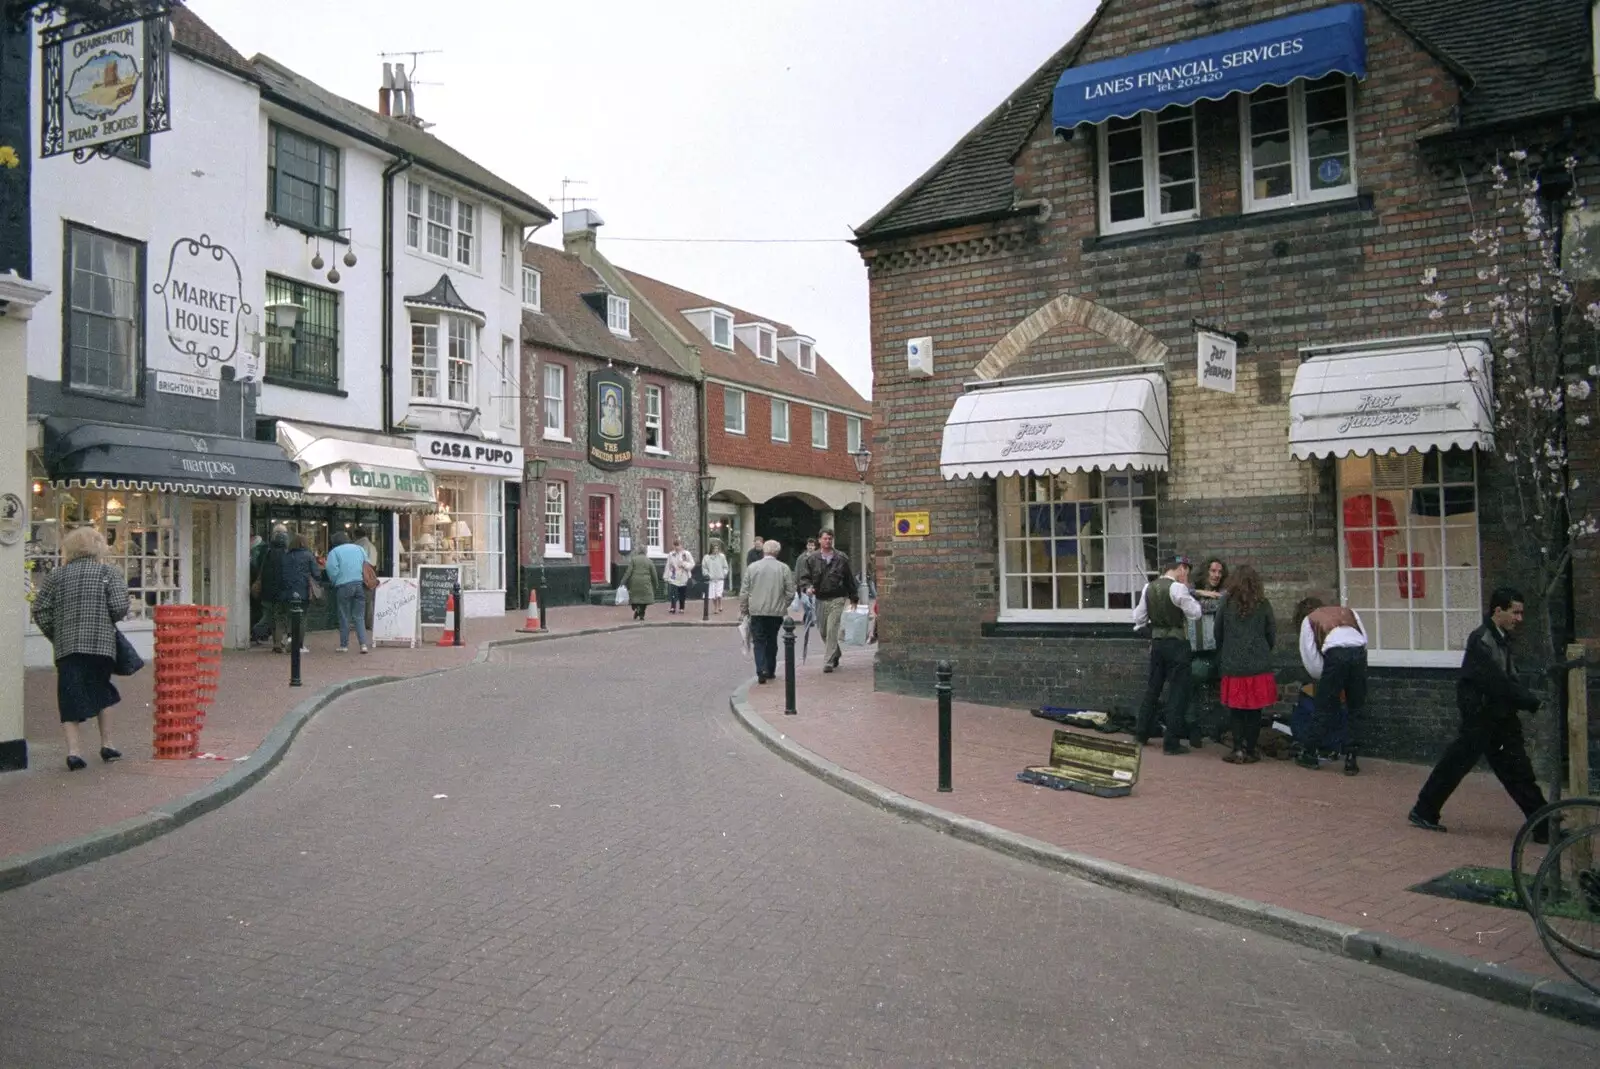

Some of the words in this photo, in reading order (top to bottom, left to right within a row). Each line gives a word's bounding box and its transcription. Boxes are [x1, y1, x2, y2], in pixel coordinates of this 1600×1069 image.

[73, 27, 134, 59] CHARRINGTON
[1085, 76, 1134, 100] LANES
[1138, 58, 1219, 88] FINANCIAL
[1222, 38, 1304, 69] SERVICES
[1177, 71, 1224, 89] 202420
[67, 124, 98, 143] PUMP
[102, 115, 139, 136] HOUSE
[172, 279, 238, 314] MARKET
[175, 307, 230, 338] HOUSE
[158, 380, 195, 395] BRIGHTON
[197, 386, 218, 398] PLACE
[430, 440, 472, 459] CASA
[475, 446, 513, 464] PUPO
[603, 441, 619, 452] THE
[182, 456, 236, 479] mariposa
[349, 469, 391, 489] GOLD
[394, 475, 430, 494] ARTS
